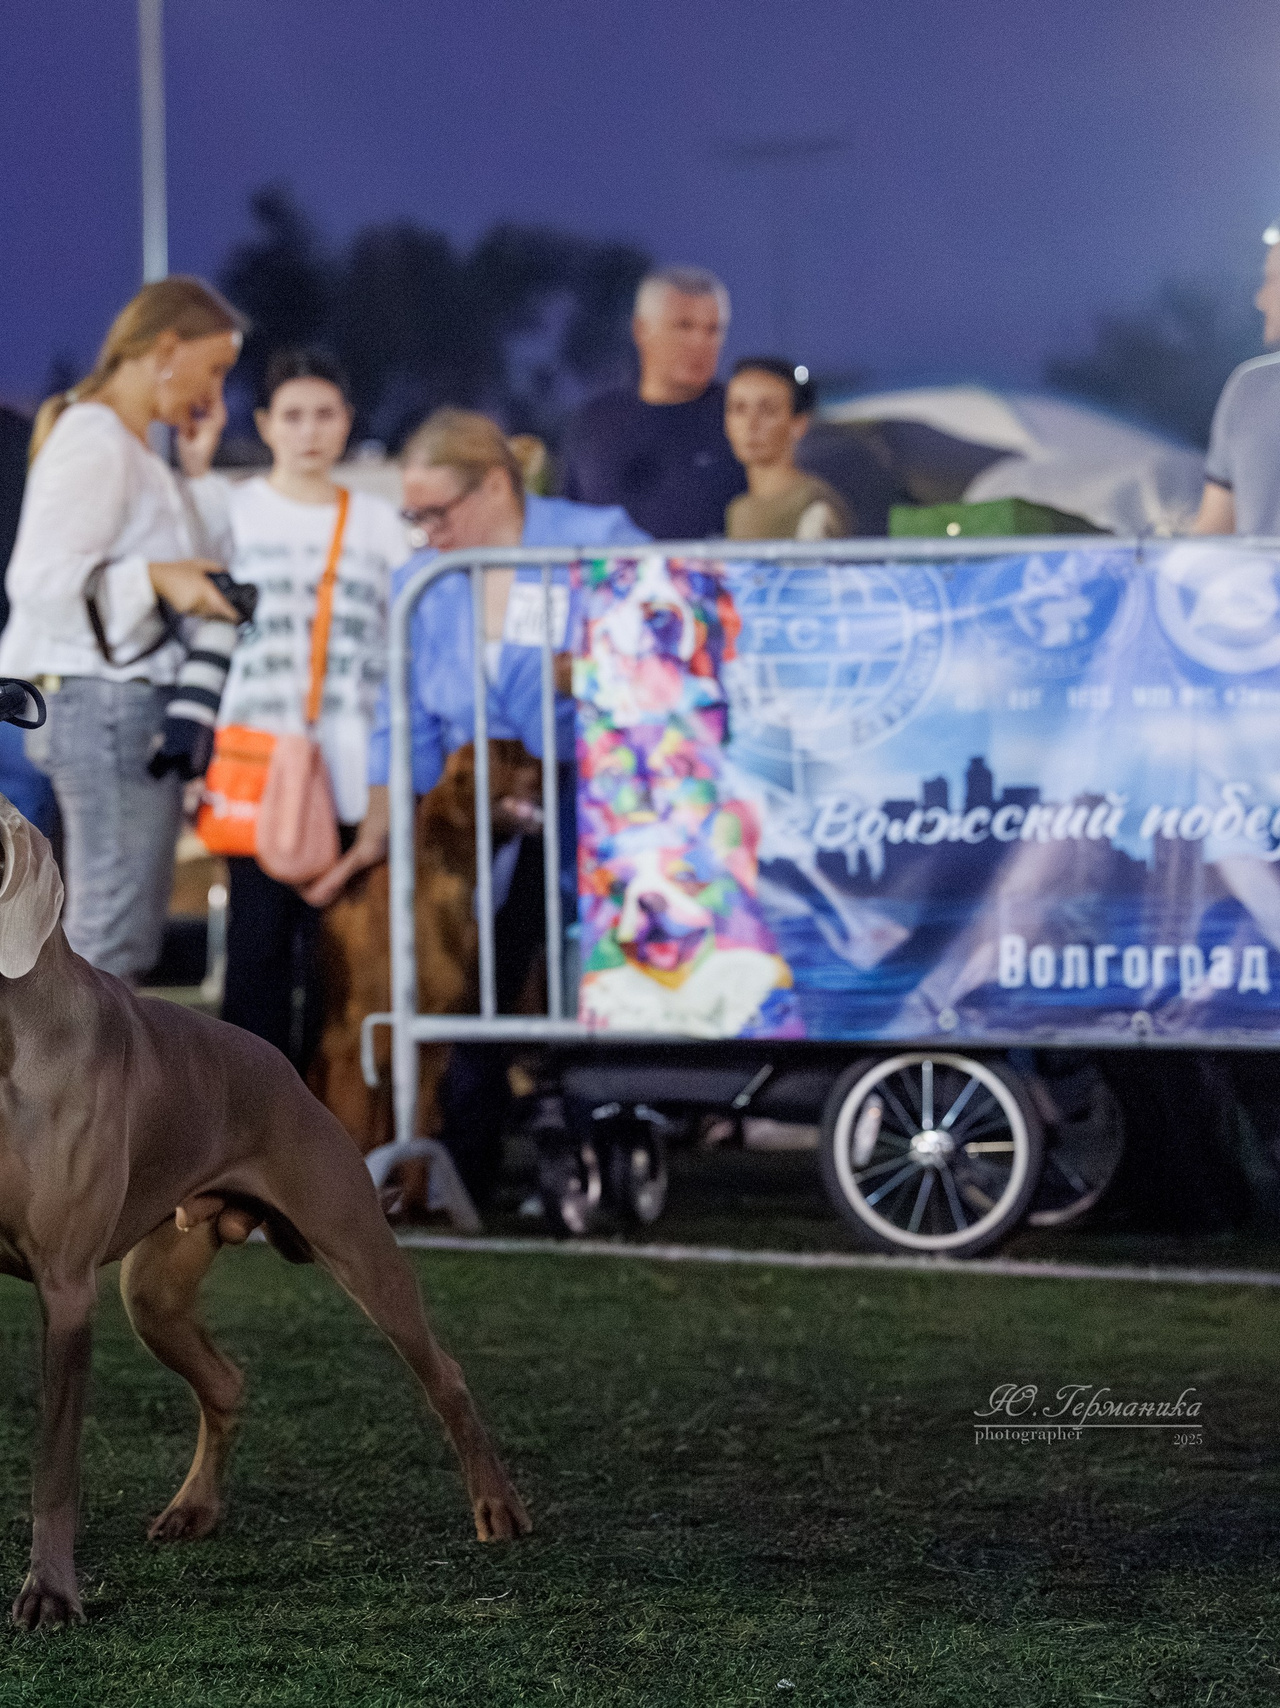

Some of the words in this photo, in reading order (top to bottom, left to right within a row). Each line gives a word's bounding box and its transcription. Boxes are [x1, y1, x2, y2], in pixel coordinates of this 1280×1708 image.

[751, 616, 851, 650] FCI
[812, 791, 1132, 851] Волжский
[997, 933, 1272, 999] Волгоград
